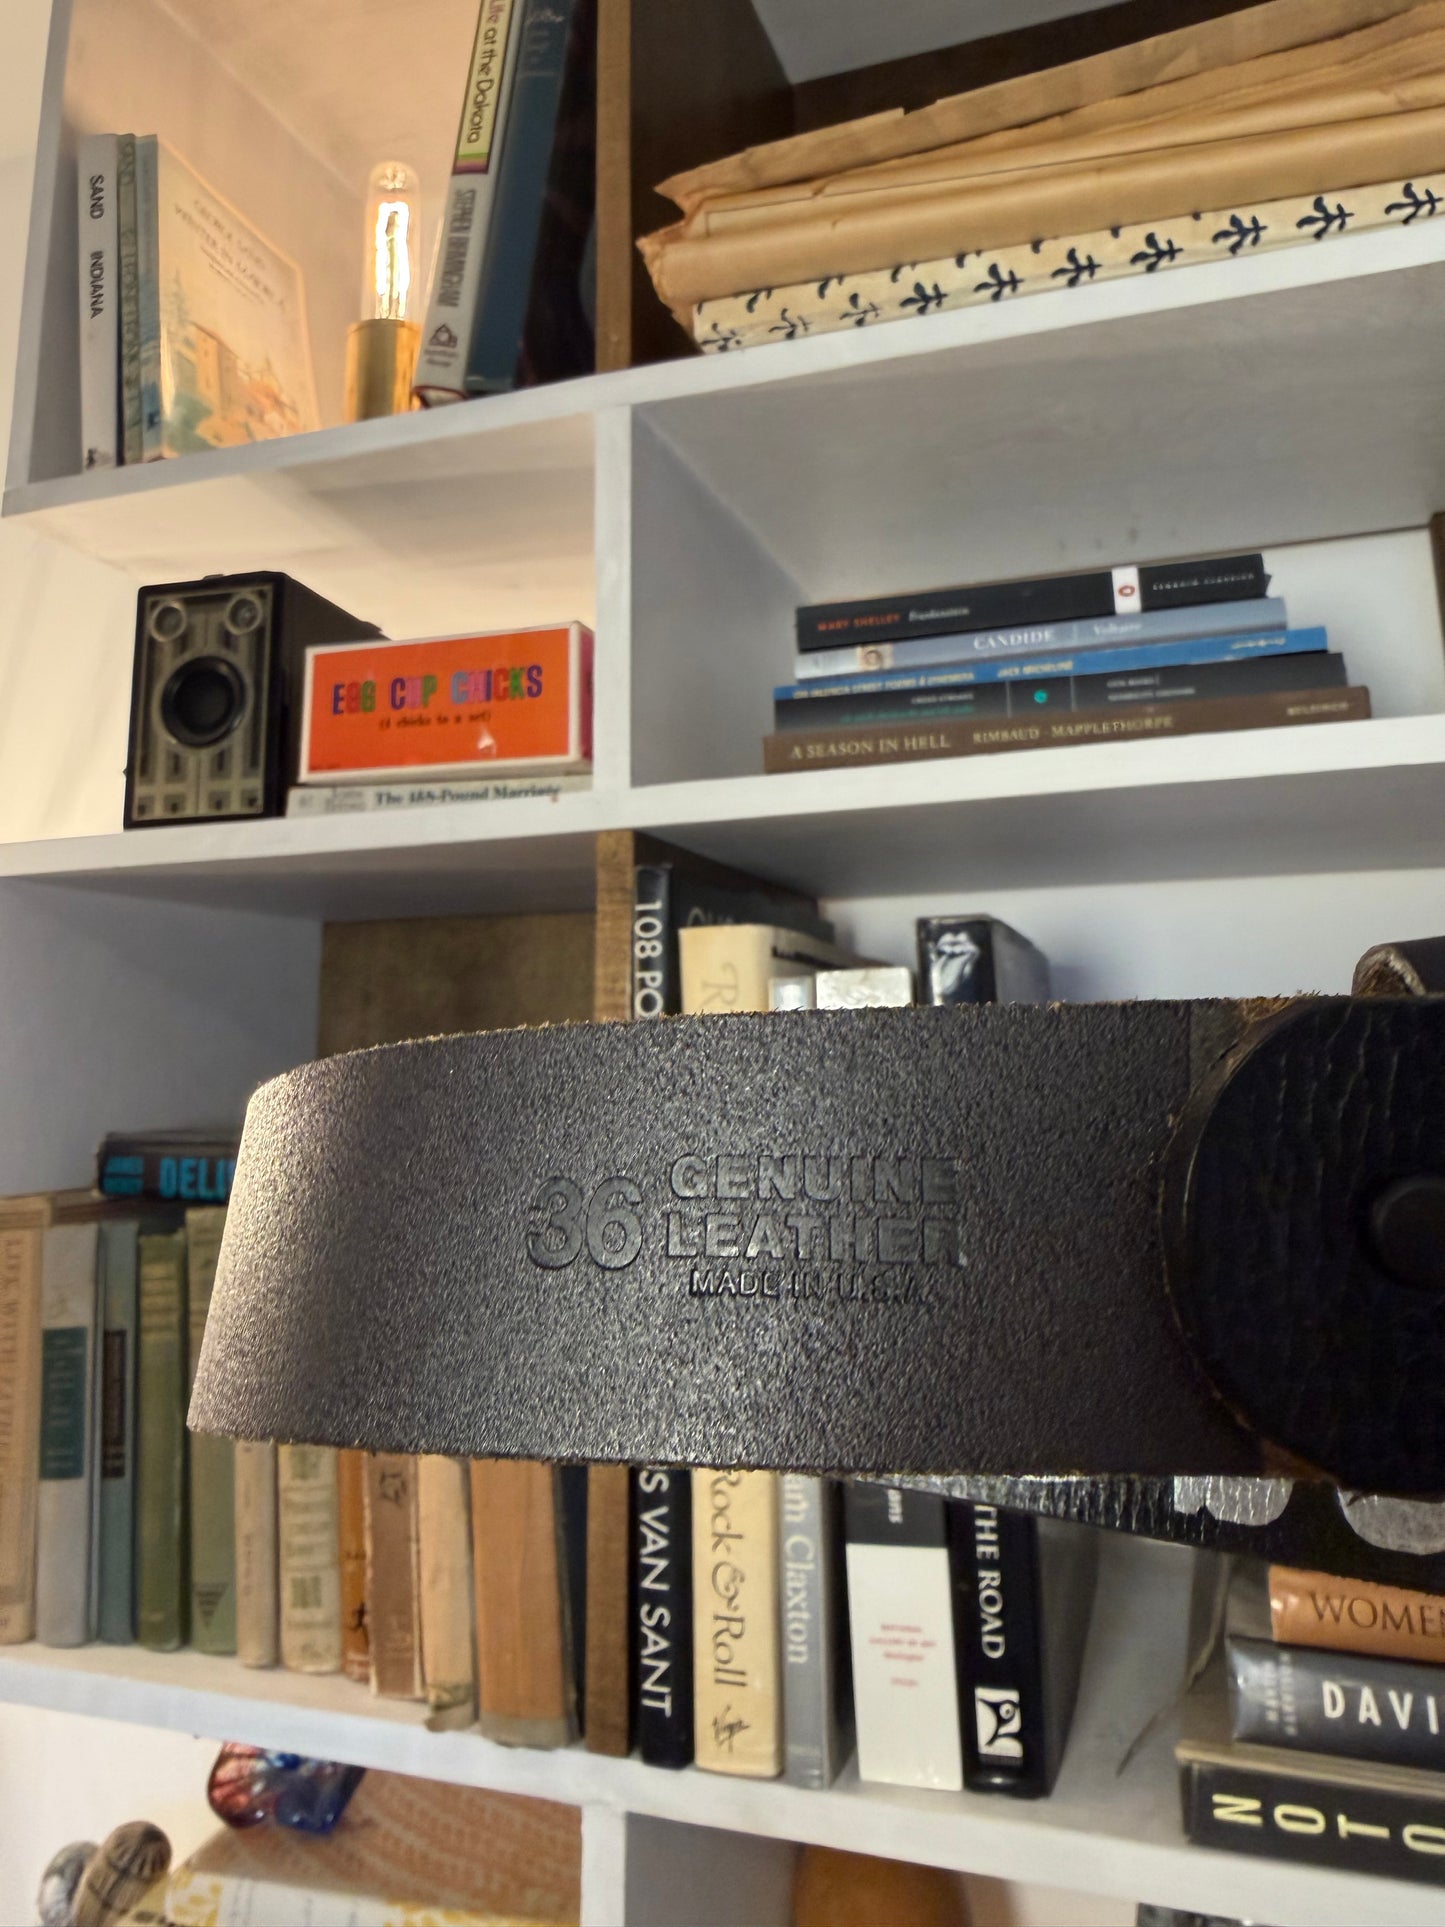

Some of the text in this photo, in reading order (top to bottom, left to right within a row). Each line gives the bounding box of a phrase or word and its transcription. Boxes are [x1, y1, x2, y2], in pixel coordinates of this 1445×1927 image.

[478, 48, 497, 77] the
[484, 27, 496, 46] at
[467, 79, 494, 143] Dakota
[89, 174, 104, 319] SAND INDIANA
[974, 629, 1055, 649] CANDIDE
[332, 664, 543, 716] EGG CUP CHICKS
[791, 715, 1175, 760] A SEASON IN HELL RIMBAUD MAPPLETHORPE
[375, 791, 401, 805] The
[634, 900, 663, 959] 108
[670, 1153, 958, 1203] GENUINE
[526, 1174, 643, 1271] 36
[665, 1210, 967, 1268] LEATHER
[639, 1505, 670, 1591] VAN
[786, 1535, 816, 1664] Claxton
[974, 1504, 1006, 1660] THE ROAD
[1308, 1590, 1445, 1638] WOME
[640, 1603, 672, 1719] SANT
[713, 1614, 748, 1687] Roll
